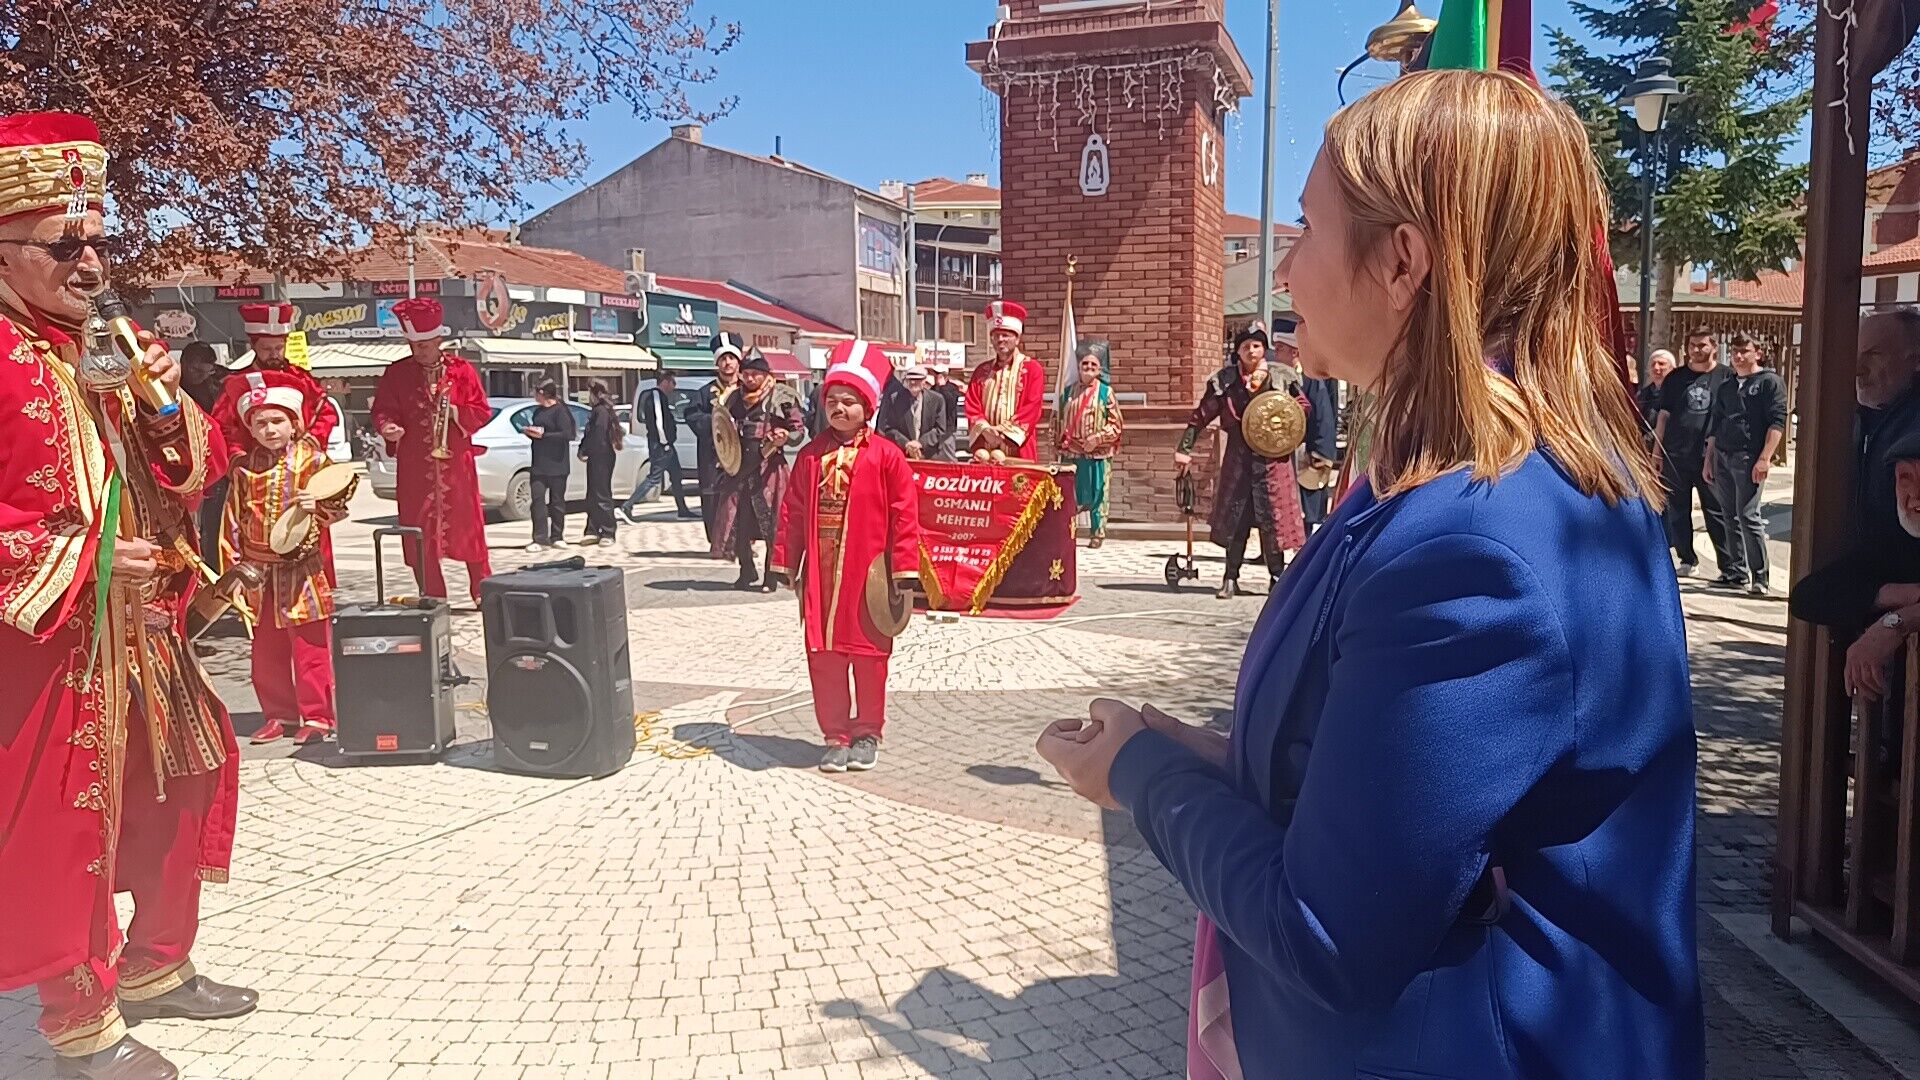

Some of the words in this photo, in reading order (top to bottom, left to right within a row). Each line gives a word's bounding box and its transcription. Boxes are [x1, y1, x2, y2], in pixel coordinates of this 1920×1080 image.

[923, 475, 1006, 494] BOZÜYÜK
[934, 498, 992, 512] OSMANLI
[936, 513, 990, 528] MEHTERİ
